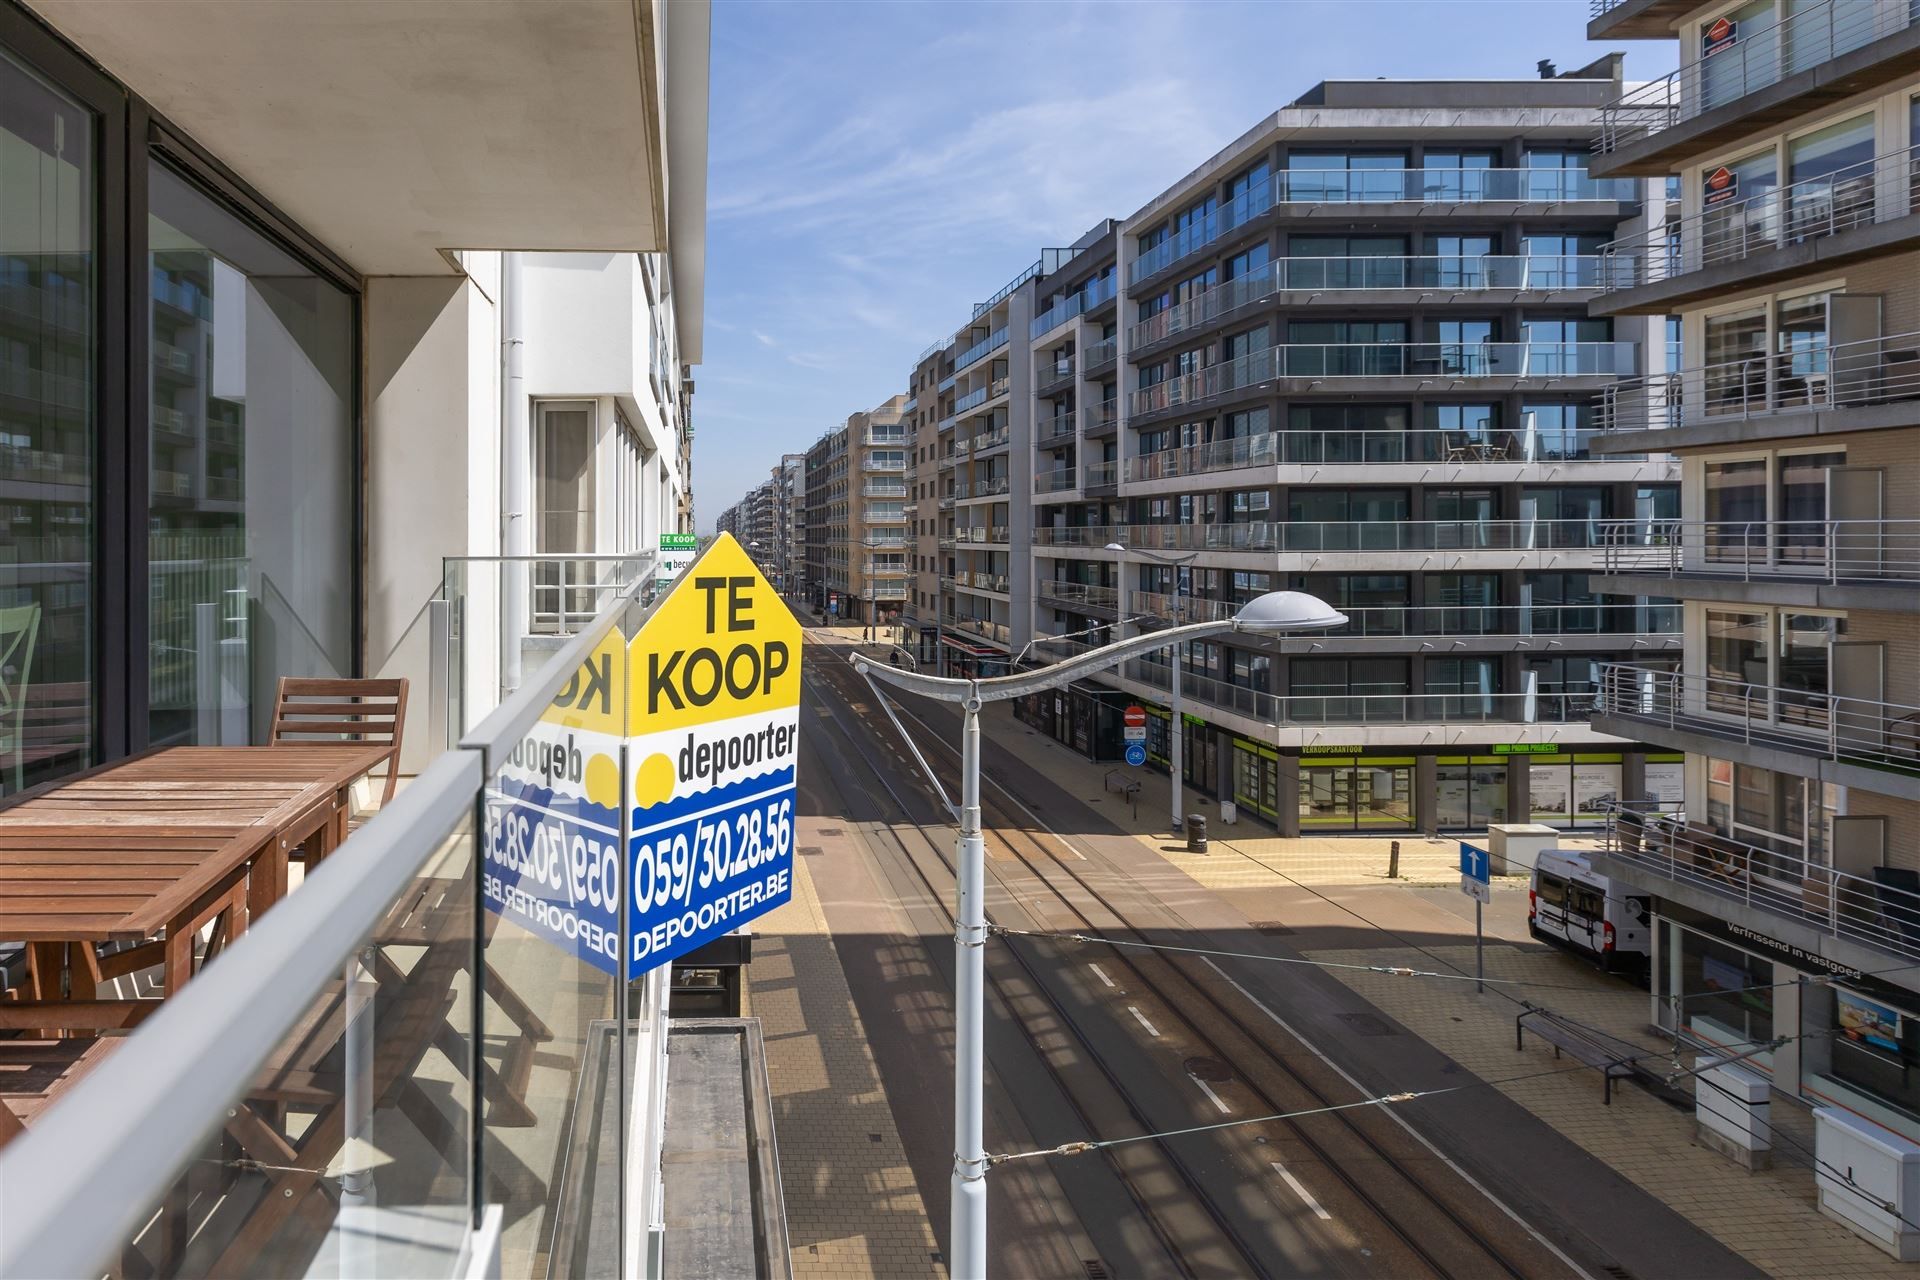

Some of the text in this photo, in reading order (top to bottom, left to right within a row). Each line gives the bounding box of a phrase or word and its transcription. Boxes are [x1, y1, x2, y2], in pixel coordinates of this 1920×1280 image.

[661, 535, 695, 543] TE KOOP
[695, 576, 755, 634] TE
[648, 640, 790, 715] KOOP
[678, 721, 797, 786] depoorter
[1302, 745, 1362, 753] VERKOOPSKANTOOR
[634, 798, 791, 914] 059/30.28.56
[634, 868, 789, 962] DEPOORTER.BE
[1727, 920, 1861, 980] Verfrissend in vastgoed
